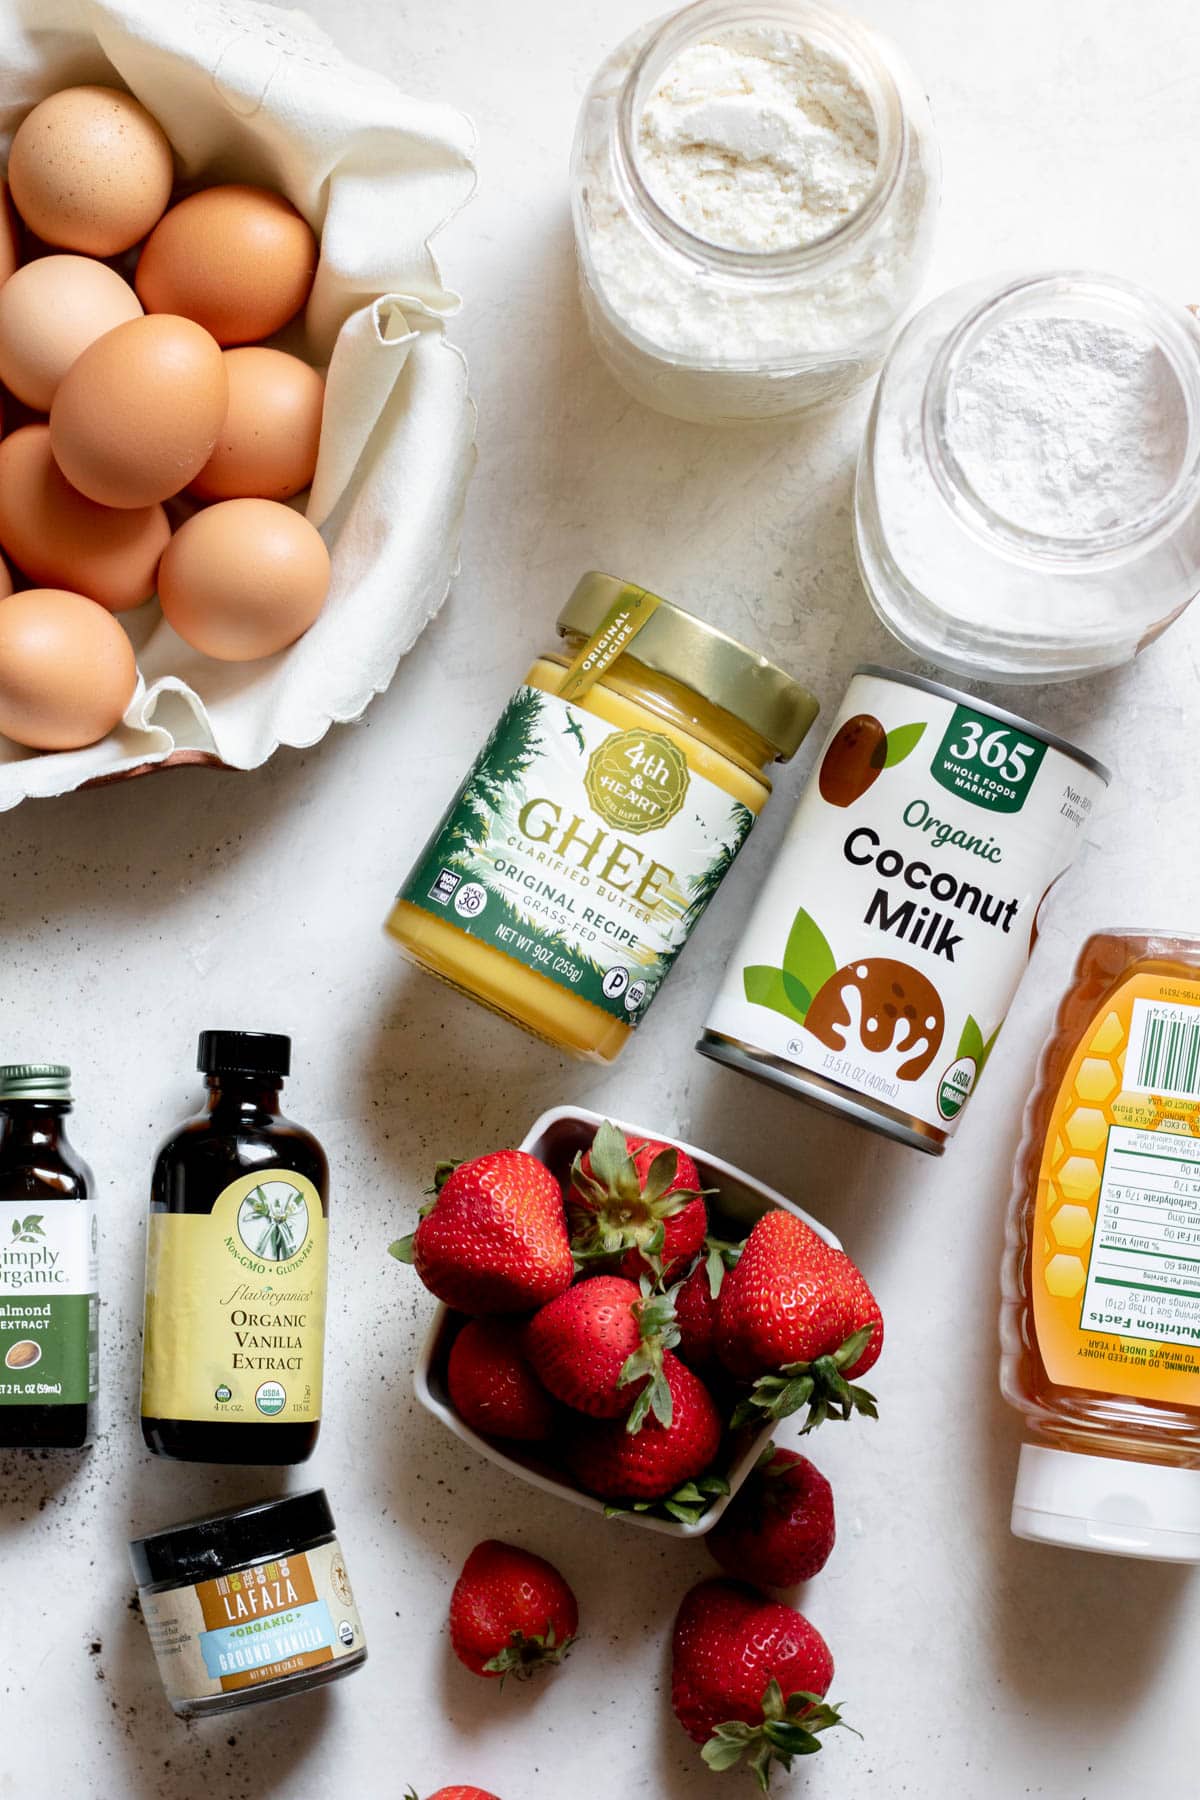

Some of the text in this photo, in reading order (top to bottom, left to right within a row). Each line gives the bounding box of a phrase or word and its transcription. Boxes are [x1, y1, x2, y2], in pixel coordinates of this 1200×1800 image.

[582, 612, 630, 671] ORIGINAL
[596, 624, 633, 669] RECIPE
[950, 722, 1035, 782] 365
[624, 741, 670, 786] 4th
[630, 774, 644, 789] &
[944, 760, 1017, 799] WHOLE FOODS
[600, 775, 662, 816] HEART
[954, 777, 998, 801] MARKET
[903, 799, 1002, 863] Organic
[518, 798, 675, 911] GHEE
[507, 836, 653, 925] CLARIFIED BUTTER
[844, 827, 1019, 934] Coconut
[494, 859, 639, 949] ORIGINAL RECIPE
[523, 895, 597, 942] GRASS-FED
[864, 888, 965, 963] Milk
[495, 923, 517, 944] NET
[516, 935, 535, 952] WT
[552, 956, 584, 983] (255g)
[608, 973, 624, 990] P
[822, 1054, 900, 1099] 13.5 FL OZ (400mL)
[952, 1069, 971, 1088] USDA
[1147, 1096, 1163, 1106] USA
[1136, 1106, 1146, 1115] CA
[1134, 1116, 1180, 1130] EXCLUSIVELY
[1173, 1180, 1189, 1192] 17g
[1125, 1190, 1140, 1201] 17g
[1143, 1193, 1197, 1210] Carbohydrate
[1167, 1211, 1186, 1223] 0mg
[1164, 1228, 1175, 1239] 0g
[1177, 1231, 1191, 1241] Fat
[1130, 1237, 1150, 1248] Daily
[0, 1246, 60, 1269] imply
[1178, 1262, 1200, 1275] lories
[0, 1269, 65, 1288] rganic
[1143, 1272, 1168, 1284] Serving
[1169, 1277, 1181, 1286] Per
[1105, 1297, 1126, 1312] (21g)
[1128, 1292, 1200, 1311] ervings about 32
[1128, 1303, 1147, 1314] Tbsp
[230, 1310, 307, 1327] ORGANIC
[1157, 1307, 1172, 1318] Size
[0, 1319, 50, 1330] EXTRACT
[1089, 1312, 1200, 1339] Nutrition Facts
[234, 1331, 303, 1348] VANILLA
[1119, 1344, 1147, 1356] UNDER
[1149, 1349, 1183, 1361] INFANTS
[232, 1353, 304, 1370] EXTRACT
[1077, 1347, 1200, 1375] WARNING: DO NOT FEED HONEY
[1185, 1354, 1195, 1364] TO
[7, 1384, 13, 1394] 2
[24, 1384, 36, 1394] OZ
[37, 1382, 62, 1395] (59mL)
[262, 1388, 281, 1397] USDA
[223, 1578, 298, 1621] LAFAZA
[236, 1613, 294, 1638] ORGANIC
[219, 1641, 272, 1672] GROUND
